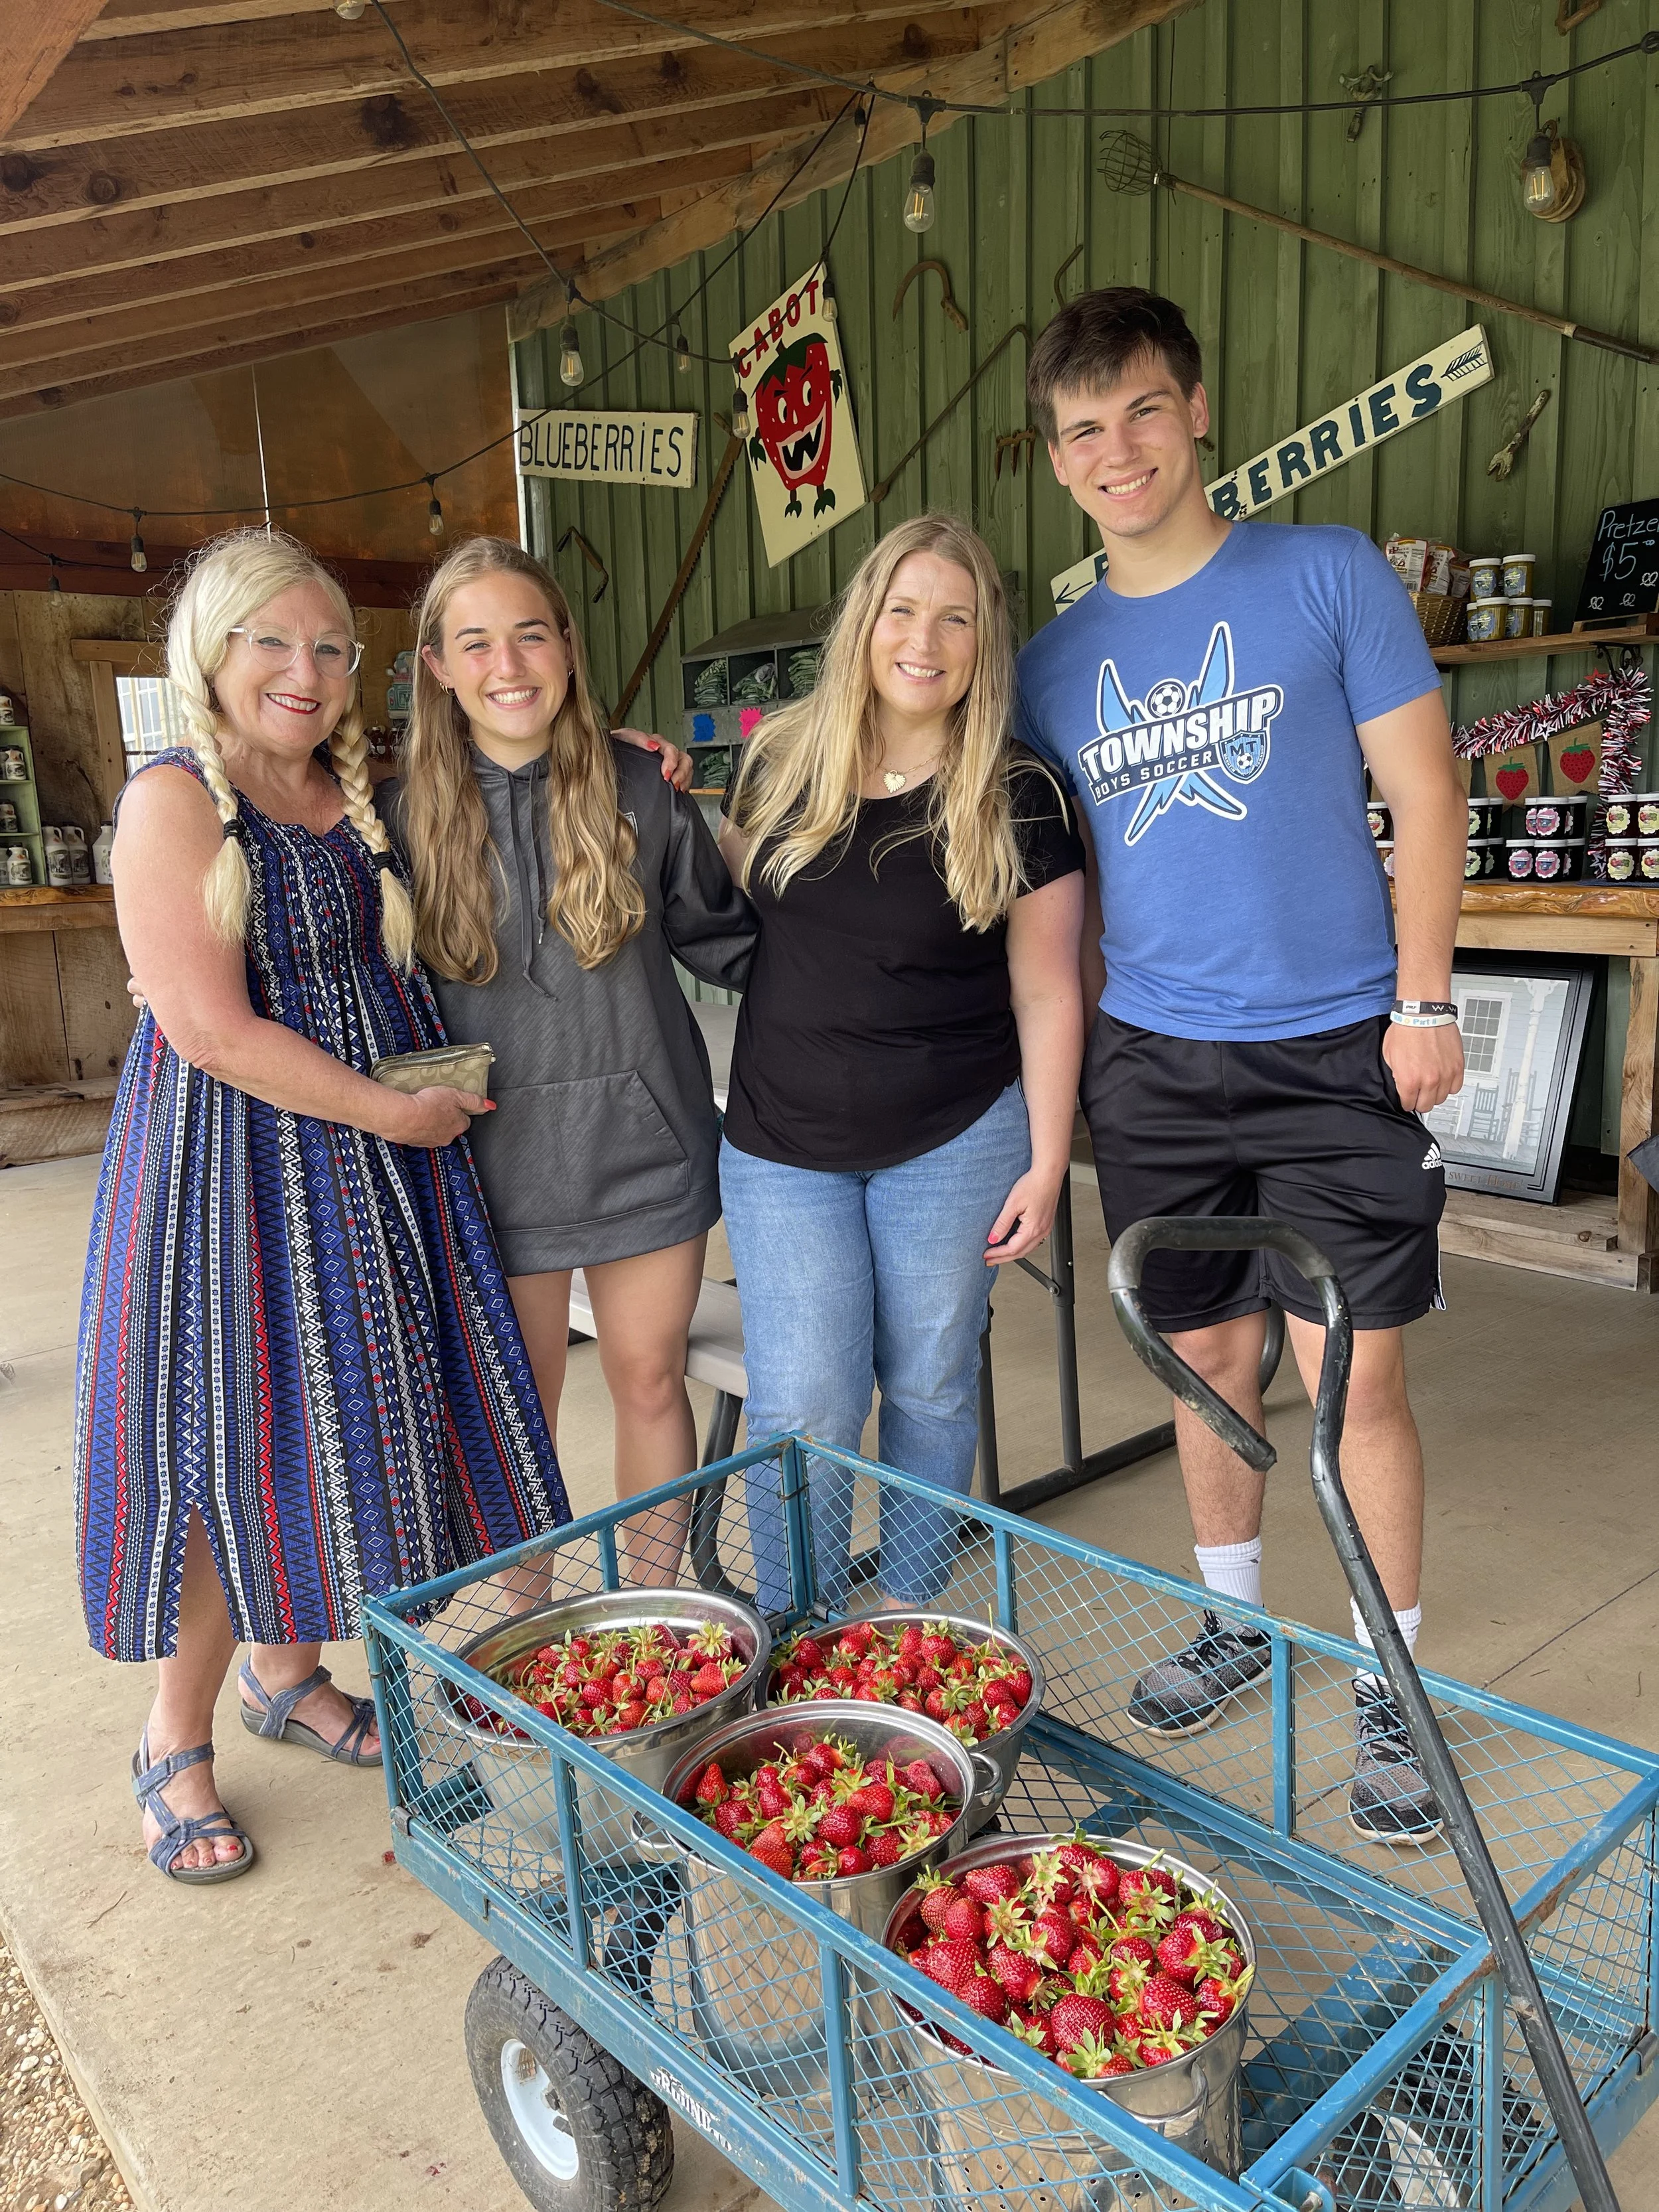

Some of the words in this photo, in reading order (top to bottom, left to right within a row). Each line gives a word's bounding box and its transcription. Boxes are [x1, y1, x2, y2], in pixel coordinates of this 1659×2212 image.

[739, 279, 820, 378] CABOT
[1598, 510, 1659, 541] Pretze
[1083, 692, 1277, 782] TOWNSHIP
[1230, 740, 1257, 757] MT
[1095, 773, 1131, 799] BOYS
[1141, 751, 1212, 780] SOCCER
